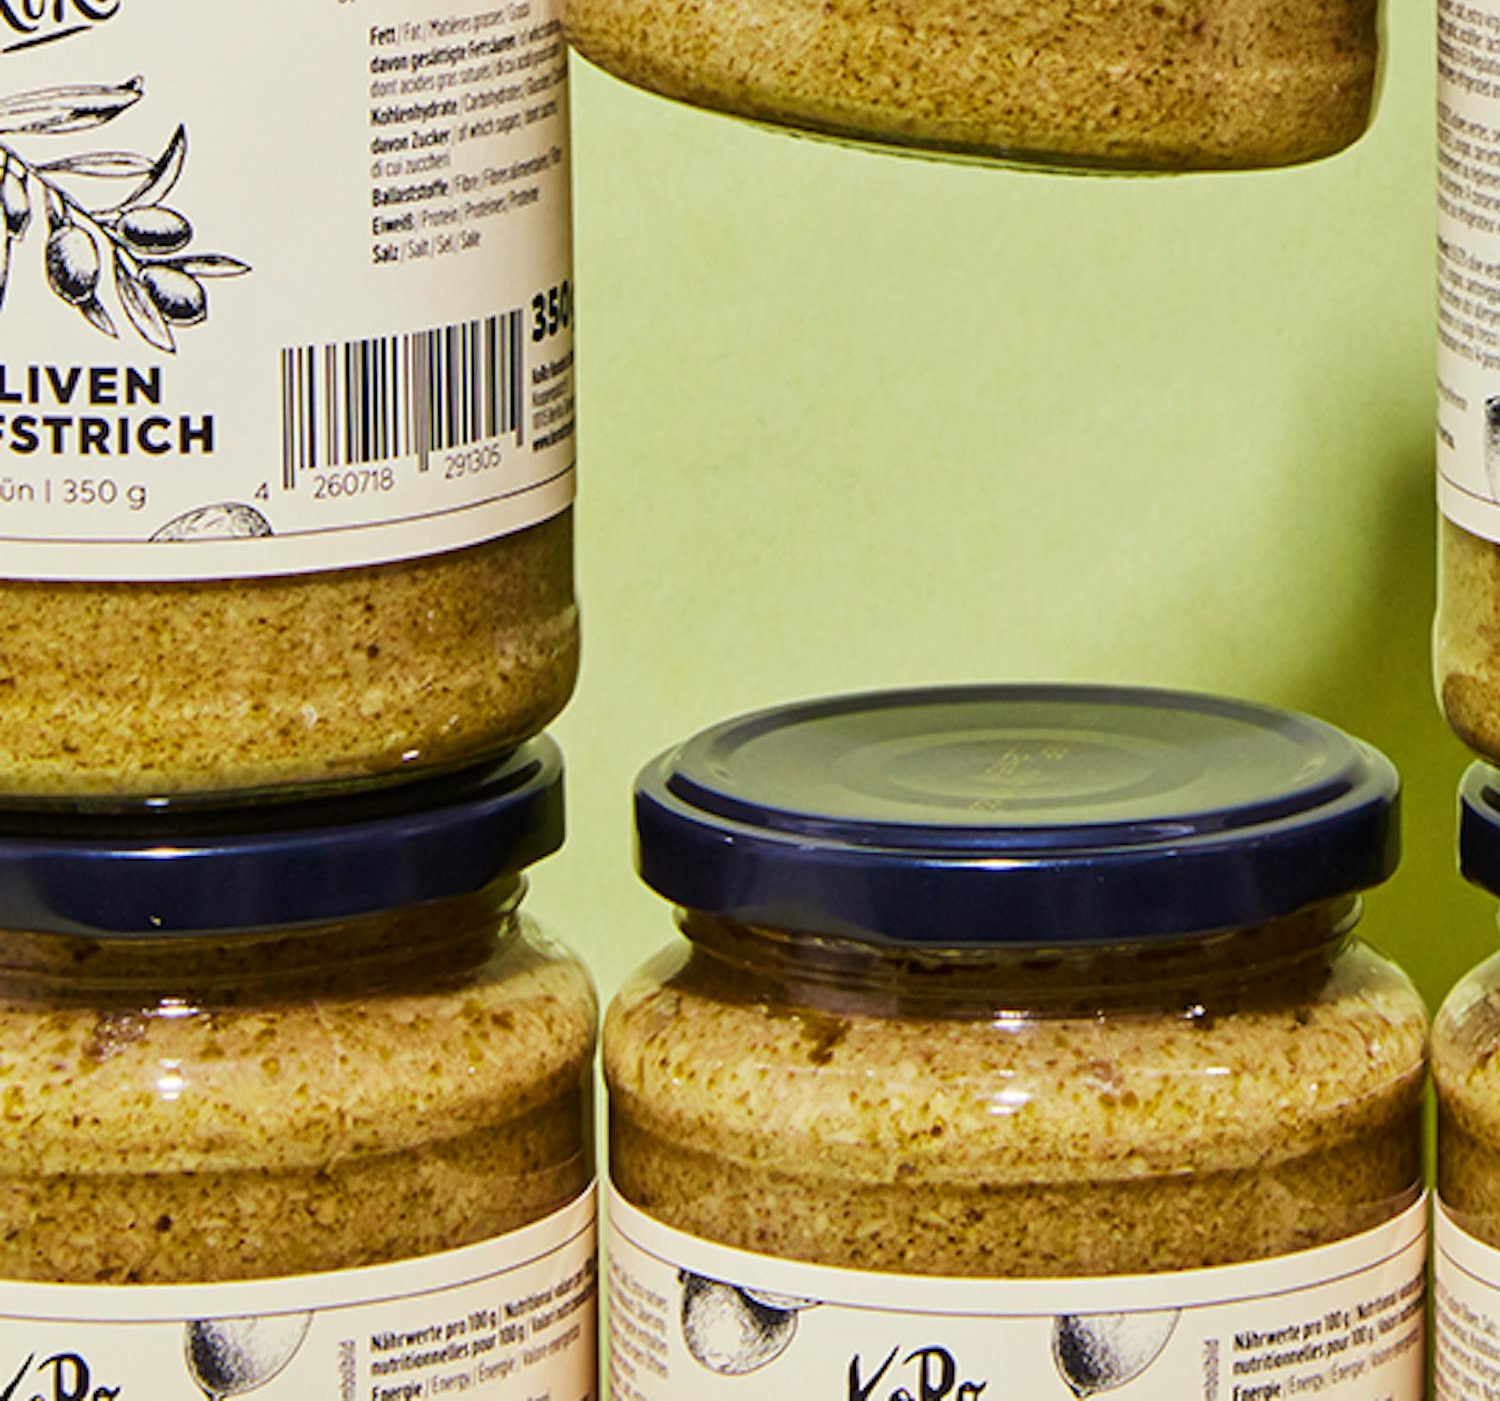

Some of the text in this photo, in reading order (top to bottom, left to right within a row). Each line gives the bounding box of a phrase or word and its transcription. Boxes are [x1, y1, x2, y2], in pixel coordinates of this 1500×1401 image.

[370, 25, 395, 46] Fett
[372, 245, 399, 263] Salz
[0, 365, 161, 405] LIVEN
[0, 415, 214, 454] STRICH
[254, 444, 502, 500] 4 260718 291305
[0, 478, 146, 510] ün 350 g
[370, 1325, 442, 1352] Nährwerte
